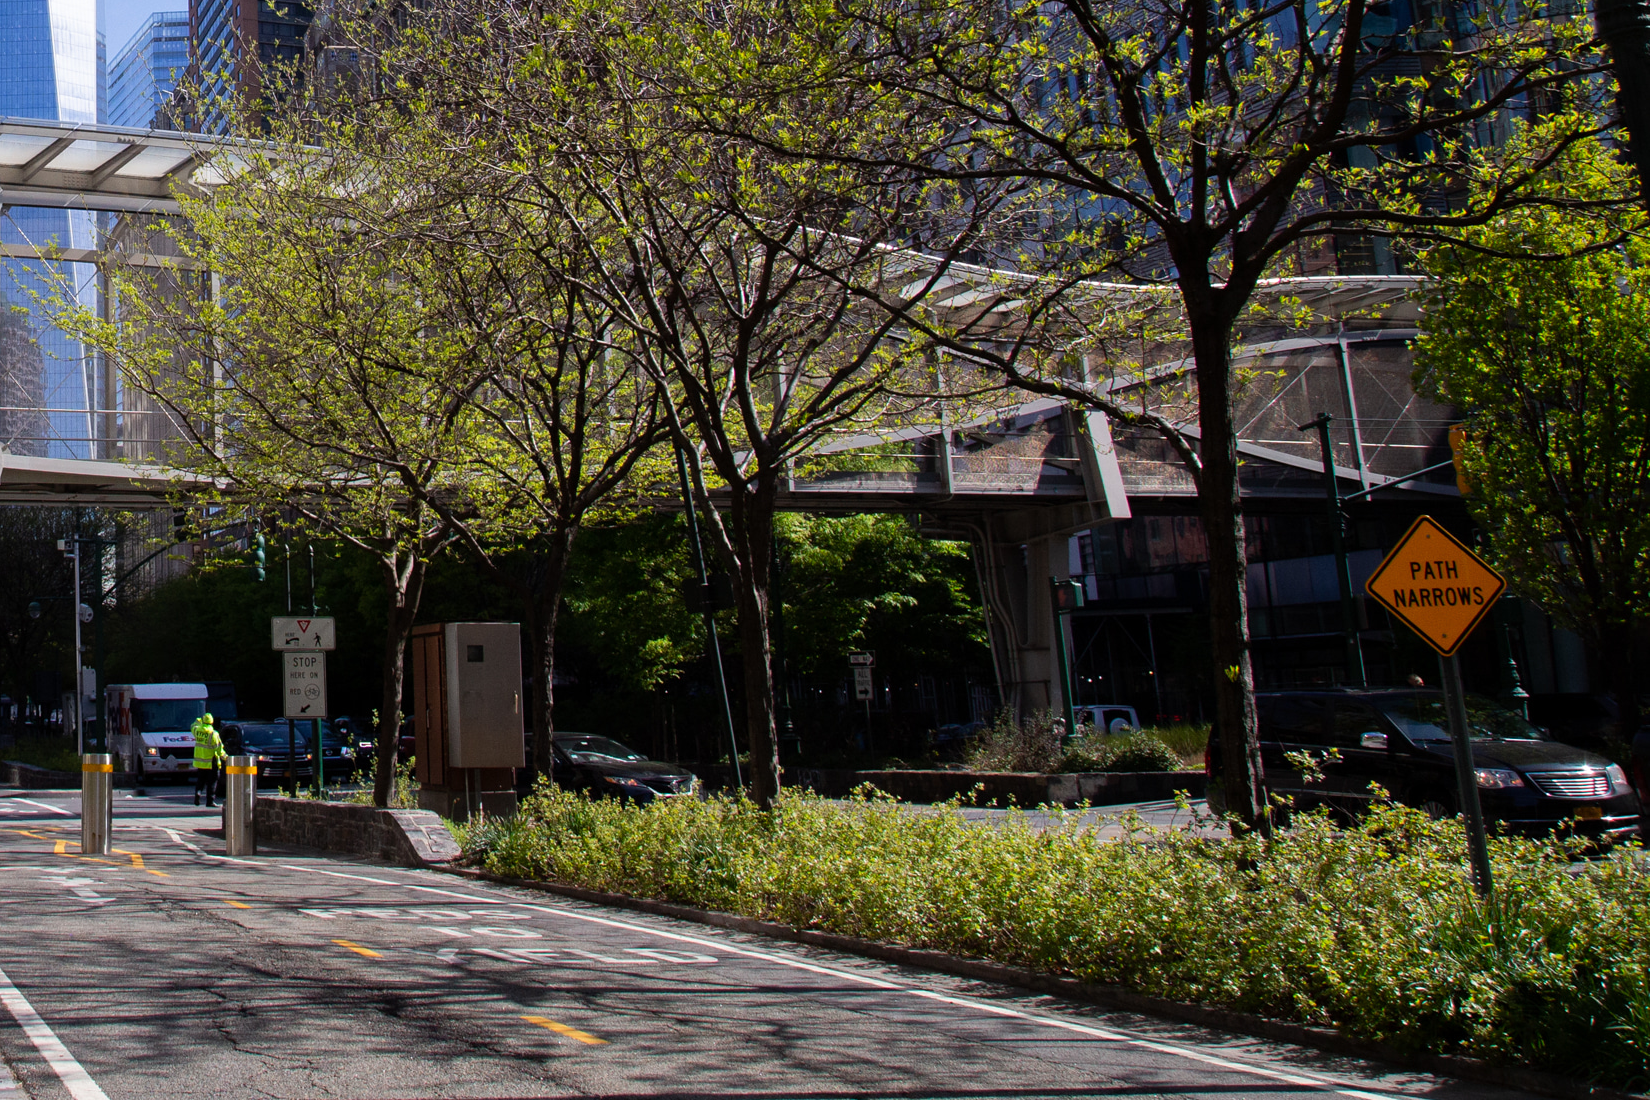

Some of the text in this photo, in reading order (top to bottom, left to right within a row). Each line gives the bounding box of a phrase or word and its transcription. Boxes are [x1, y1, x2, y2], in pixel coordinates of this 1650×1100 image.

[1409, 560, 1459, 581] PATH
[1393, 586, 1485, 608] NARROWS
[292, 657, 317, 668] STOP
[289, 671, 319, 679] HERE ON
[289, 688, 302, 696] RED
[162, 735, 196, 743] FedEx
[297, 908, 533, 921] PEDS
[418, 926, 543, 939] TO
[392, 947, 720, 965] YIELD
